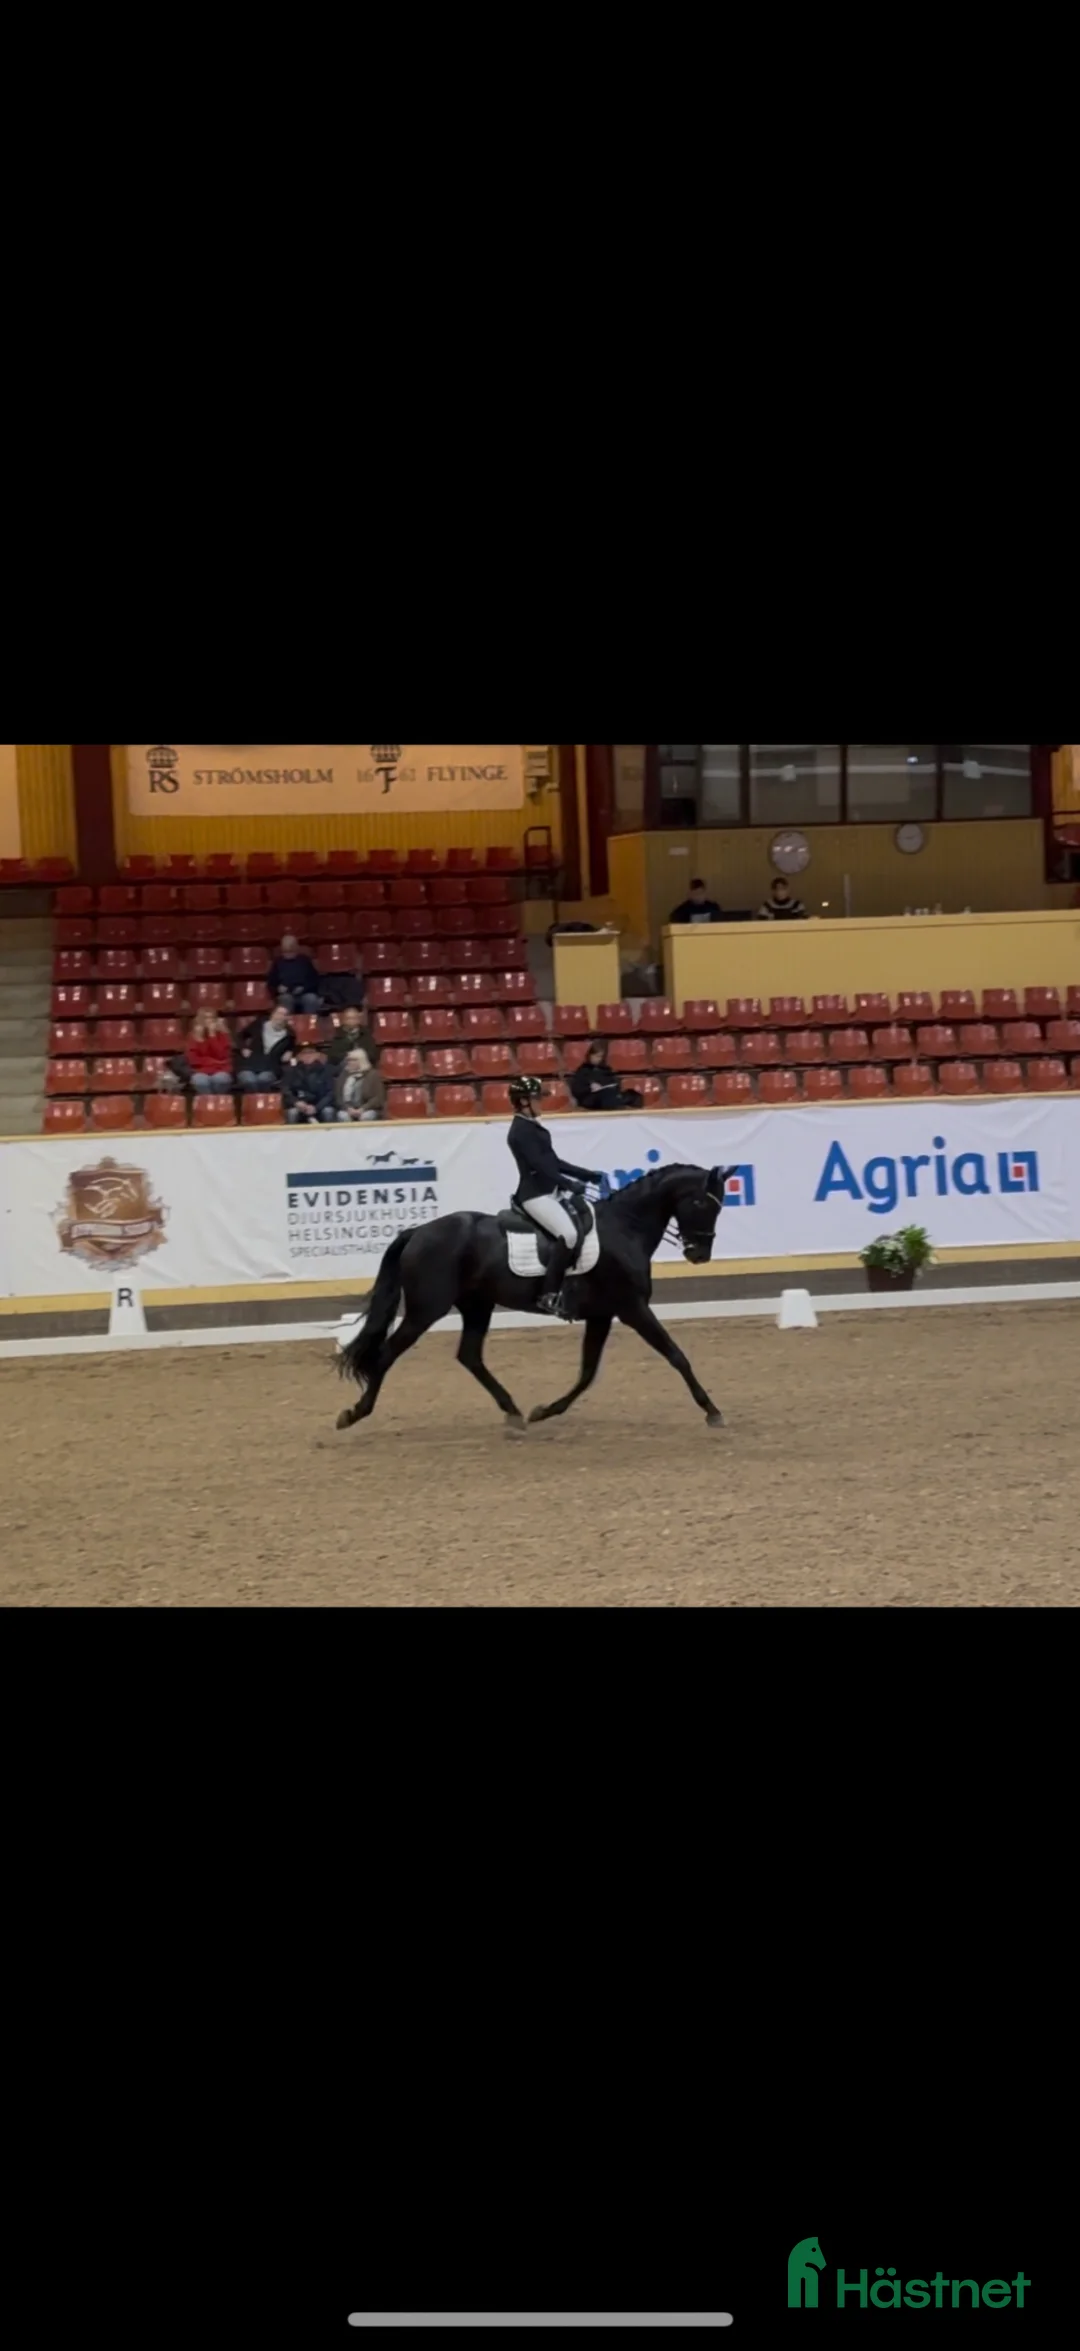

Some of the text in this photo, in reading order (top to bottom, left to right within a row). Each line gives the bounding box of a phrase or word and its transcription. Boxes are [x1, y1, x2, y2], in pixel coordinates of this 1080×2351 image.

[193, 767, 334, 786] STRÖMSHOLM
[427, 765, 508, 782] FLYINGE
[814, 1136, 991, 1214] Agria
[287, 1186, 438, 1208] EVIDENSIA
[287, 1205, 439, 1226] DJURSJUKHUSET
[288, 1223, 418, 1242] HELSINGBOR
[117, 1287, 133, 1307] R
